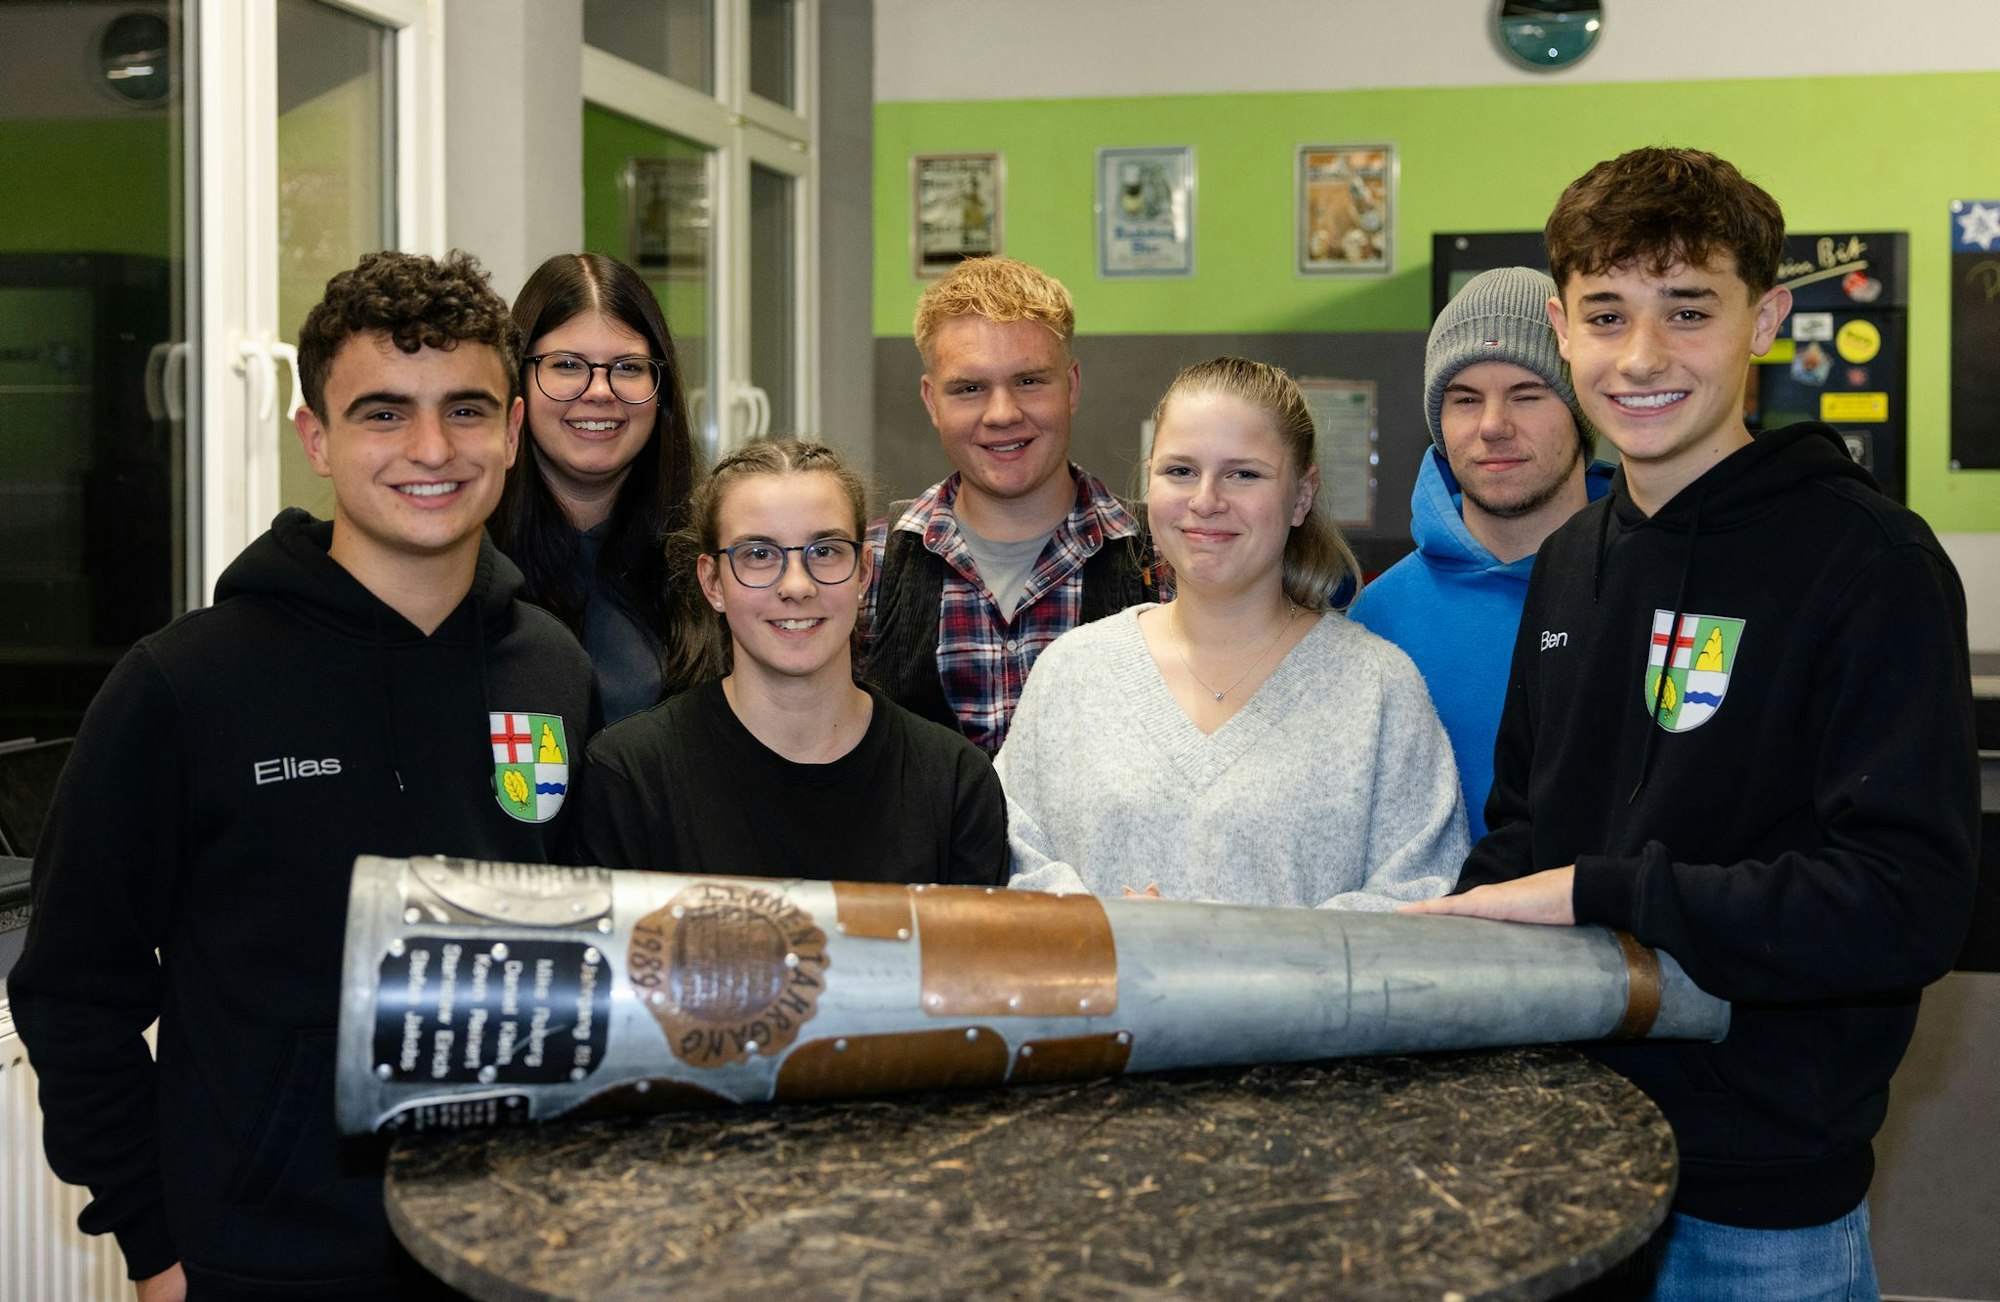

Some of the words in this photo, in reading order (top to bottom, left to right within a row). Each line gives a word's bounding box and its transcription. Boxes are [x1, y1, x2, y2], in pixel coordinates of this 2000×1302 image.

[1776, 257, 1815, 279] ein
[1817, 235, 1868, 268] Bit
[1540, 630, 1568, 652] Ben
[254, 757, 342, 785] Elias
[630, 925, 663, 988] 1989
[501, 959, 523, 1015] Daniel
[572, 963, 598, 1040] Jahrgang
[497, 1020, 518, 1066] Klein
